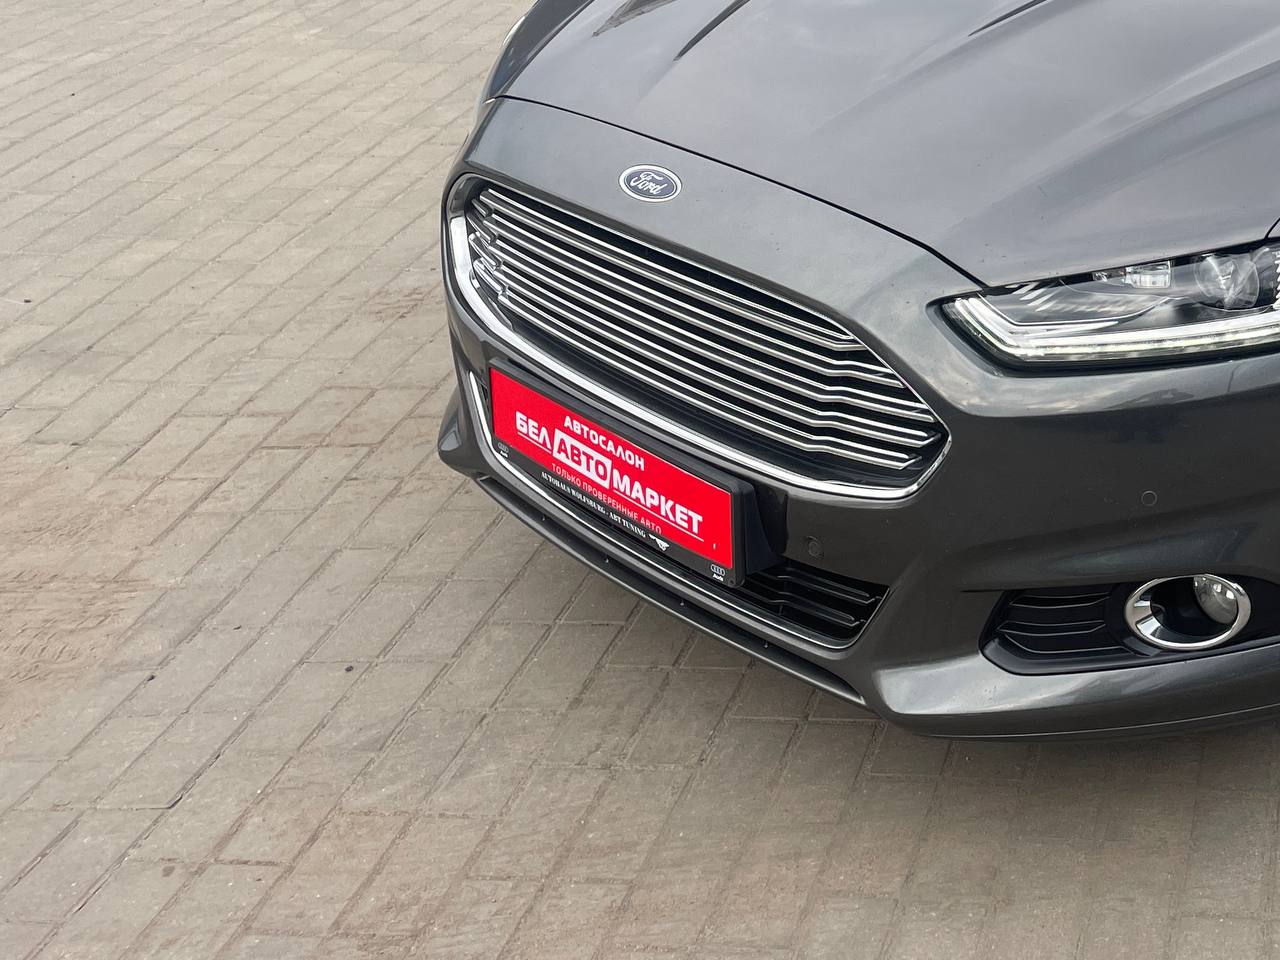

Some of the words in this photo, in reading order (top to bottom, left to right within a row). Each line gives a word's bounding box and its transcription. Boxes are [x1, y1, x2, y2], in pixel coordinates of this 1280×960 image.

[630, 171, 668, 194] Ford
[563, 415, 645, 471] АВТОСАЛОН
[515, 411, 550, 450] БЕЛ
[555, 436, 609, 485] АВТО
[612, 472, 703, 534] МАРКЕТ
[551, 463, 581, 488] ТОЛЬКО
[582, 477, 638, 521] ПРОВЕРЕННЫЕ
[640, 516, 662, 534] АВТО
[622, 519, 647, 538] TUNING
